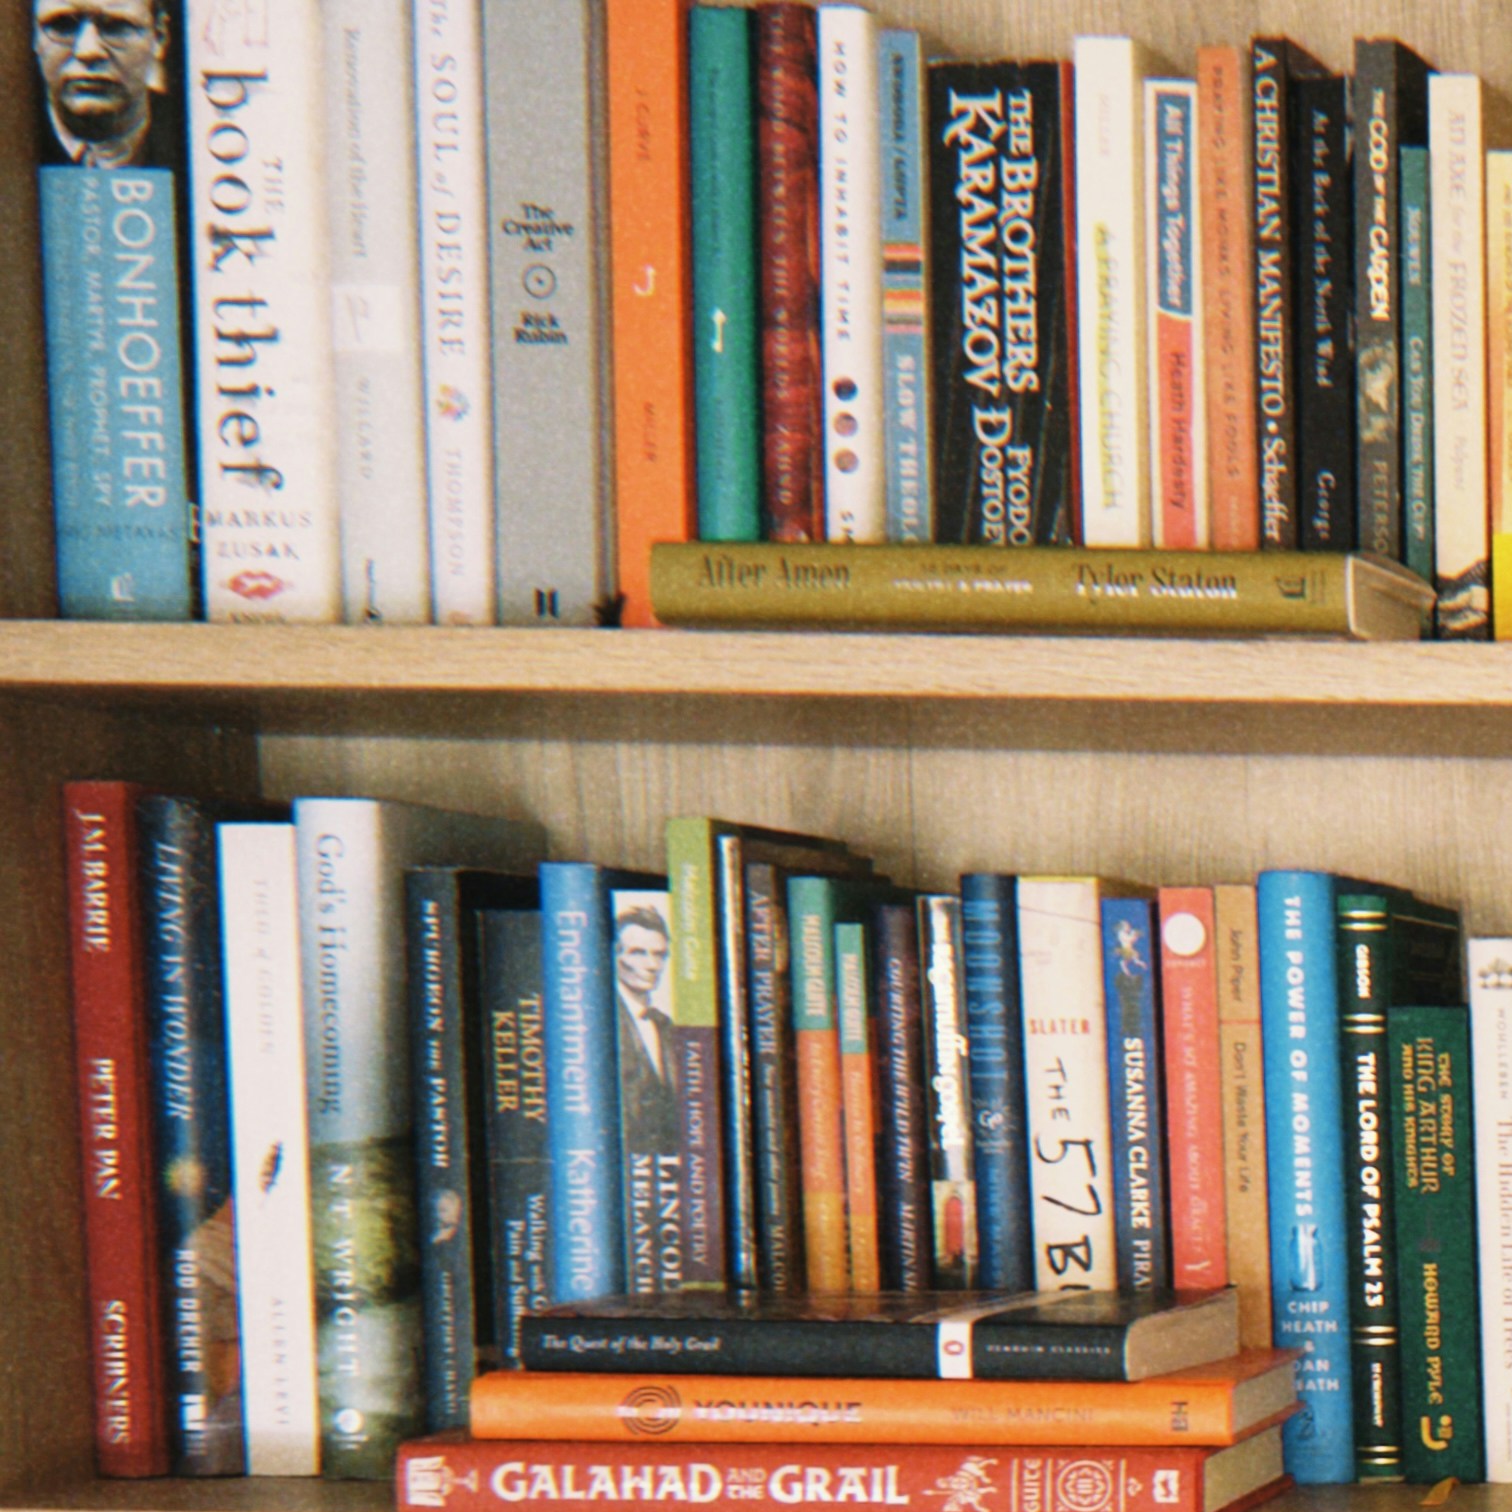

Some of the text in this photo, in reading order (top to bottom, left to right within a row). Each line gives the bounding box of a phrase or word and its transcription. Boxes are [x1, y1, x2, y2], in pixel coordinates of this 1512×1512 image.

[203, 68, 284, 494] book thief
[503, 221, 574, 238] Creative
[522, 205, 554, 219] The
[524, 237, 554, 252] Act
[943, 89, 1005, 397] KARAMAZOV
[1002, 89, 1040, 393] THE BROTHERS
[111, 177, 167, 509] BONHOEFFER
[514, 329, 569, 346] Rubin
[522, 314, 558, 329] Rick
[1252, 48, 1283, 541] A CHRISTIAN MANIFESTO Schaeffer
[697, 554, 850, 590] After Amen
[1075, 564, 1238, 604] Tyler Staton
[316, 833, 346, 1116] God's Homecoming
[492, 1007, 518, 1114] KELLER
[516, 992, 547, 1124] TIMOTHY
[1283, 895, 1314, 1218] THE POWER OF MOMENTS
[89, 1057, 120, 1202] PETER PAN
[1122, 1037, 1151, 1229] SUSANNA CLARKE
[1358, 1052, 1384, 1308] THE LORD OF PSALM 23
[492, 1463, 909, 1507] GALAHAD AND THE GRAIL
